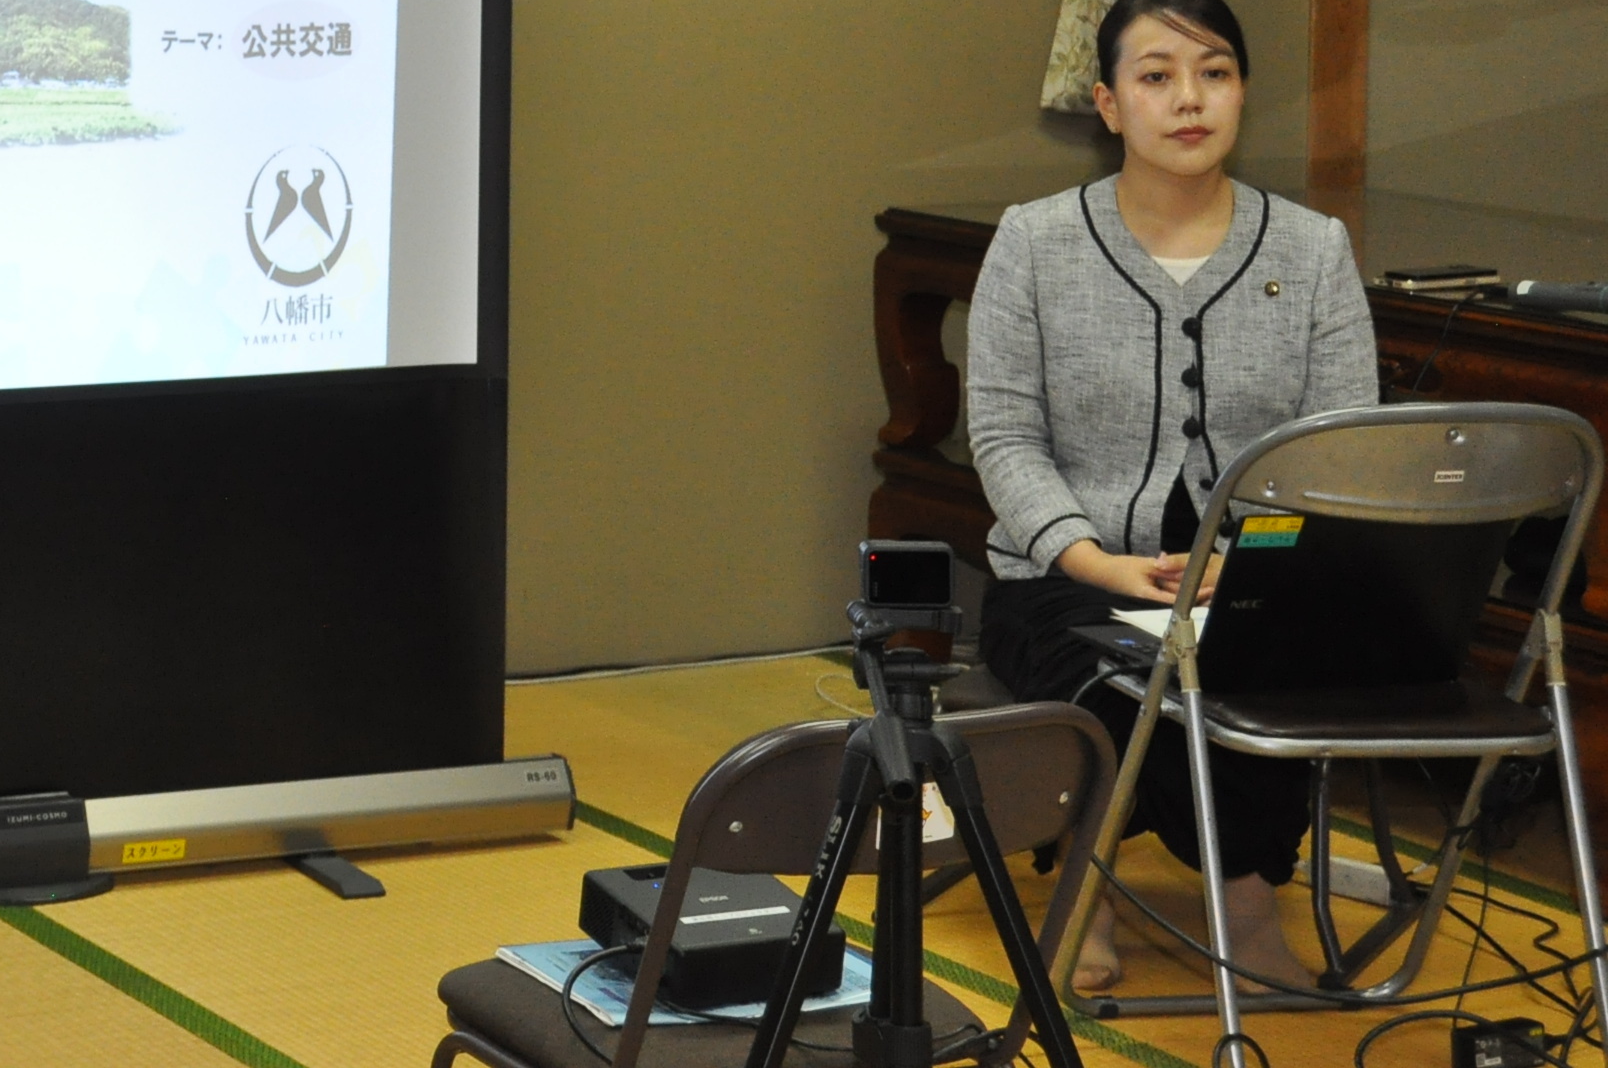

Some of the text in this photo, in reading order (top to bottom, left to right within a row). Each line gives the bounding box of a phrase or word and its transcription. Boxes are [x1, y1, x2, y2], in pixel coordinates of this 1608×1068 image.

[241, 22, 352, 58] 公共交通
[260, 293, 333, 326] 八幡市
[242, 329, 344, 346] YAWATA CITY
[1229, 599, 1264, 610] NEC
[526, 771, 557, 782] RS-60
[126, 845, 182, 859] スクリーン
